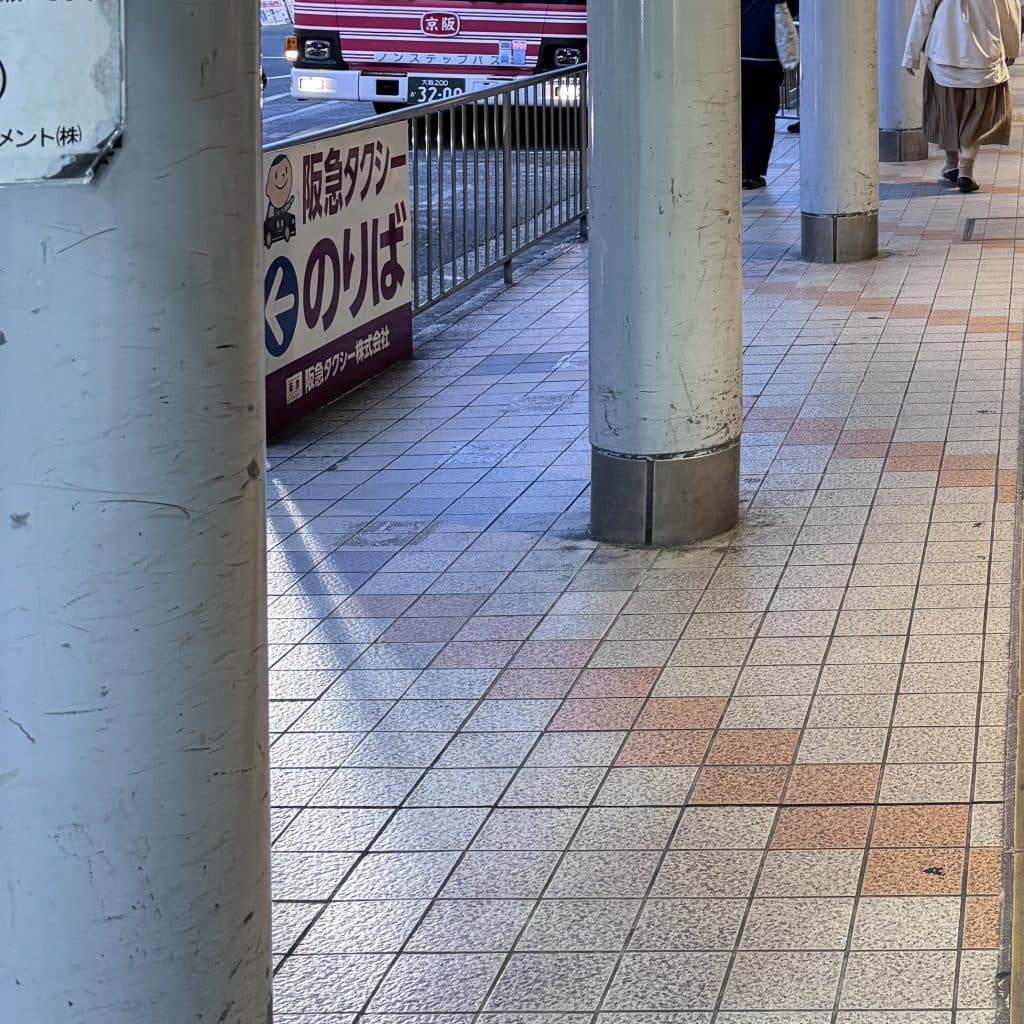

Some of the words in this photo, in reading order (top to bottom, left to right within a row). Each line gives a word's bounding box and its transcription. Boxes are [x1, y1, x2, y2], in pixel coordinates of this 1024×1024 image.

[377, 52, 500, 65] ノンステップバス
[424, 16, 456, 32] 京阪
[302, 140, 407, 225] 阪急タクシー
[302, 200, 408, 332] のりば
[304, 324, 391, 394] 阪急タクシー株式会社
